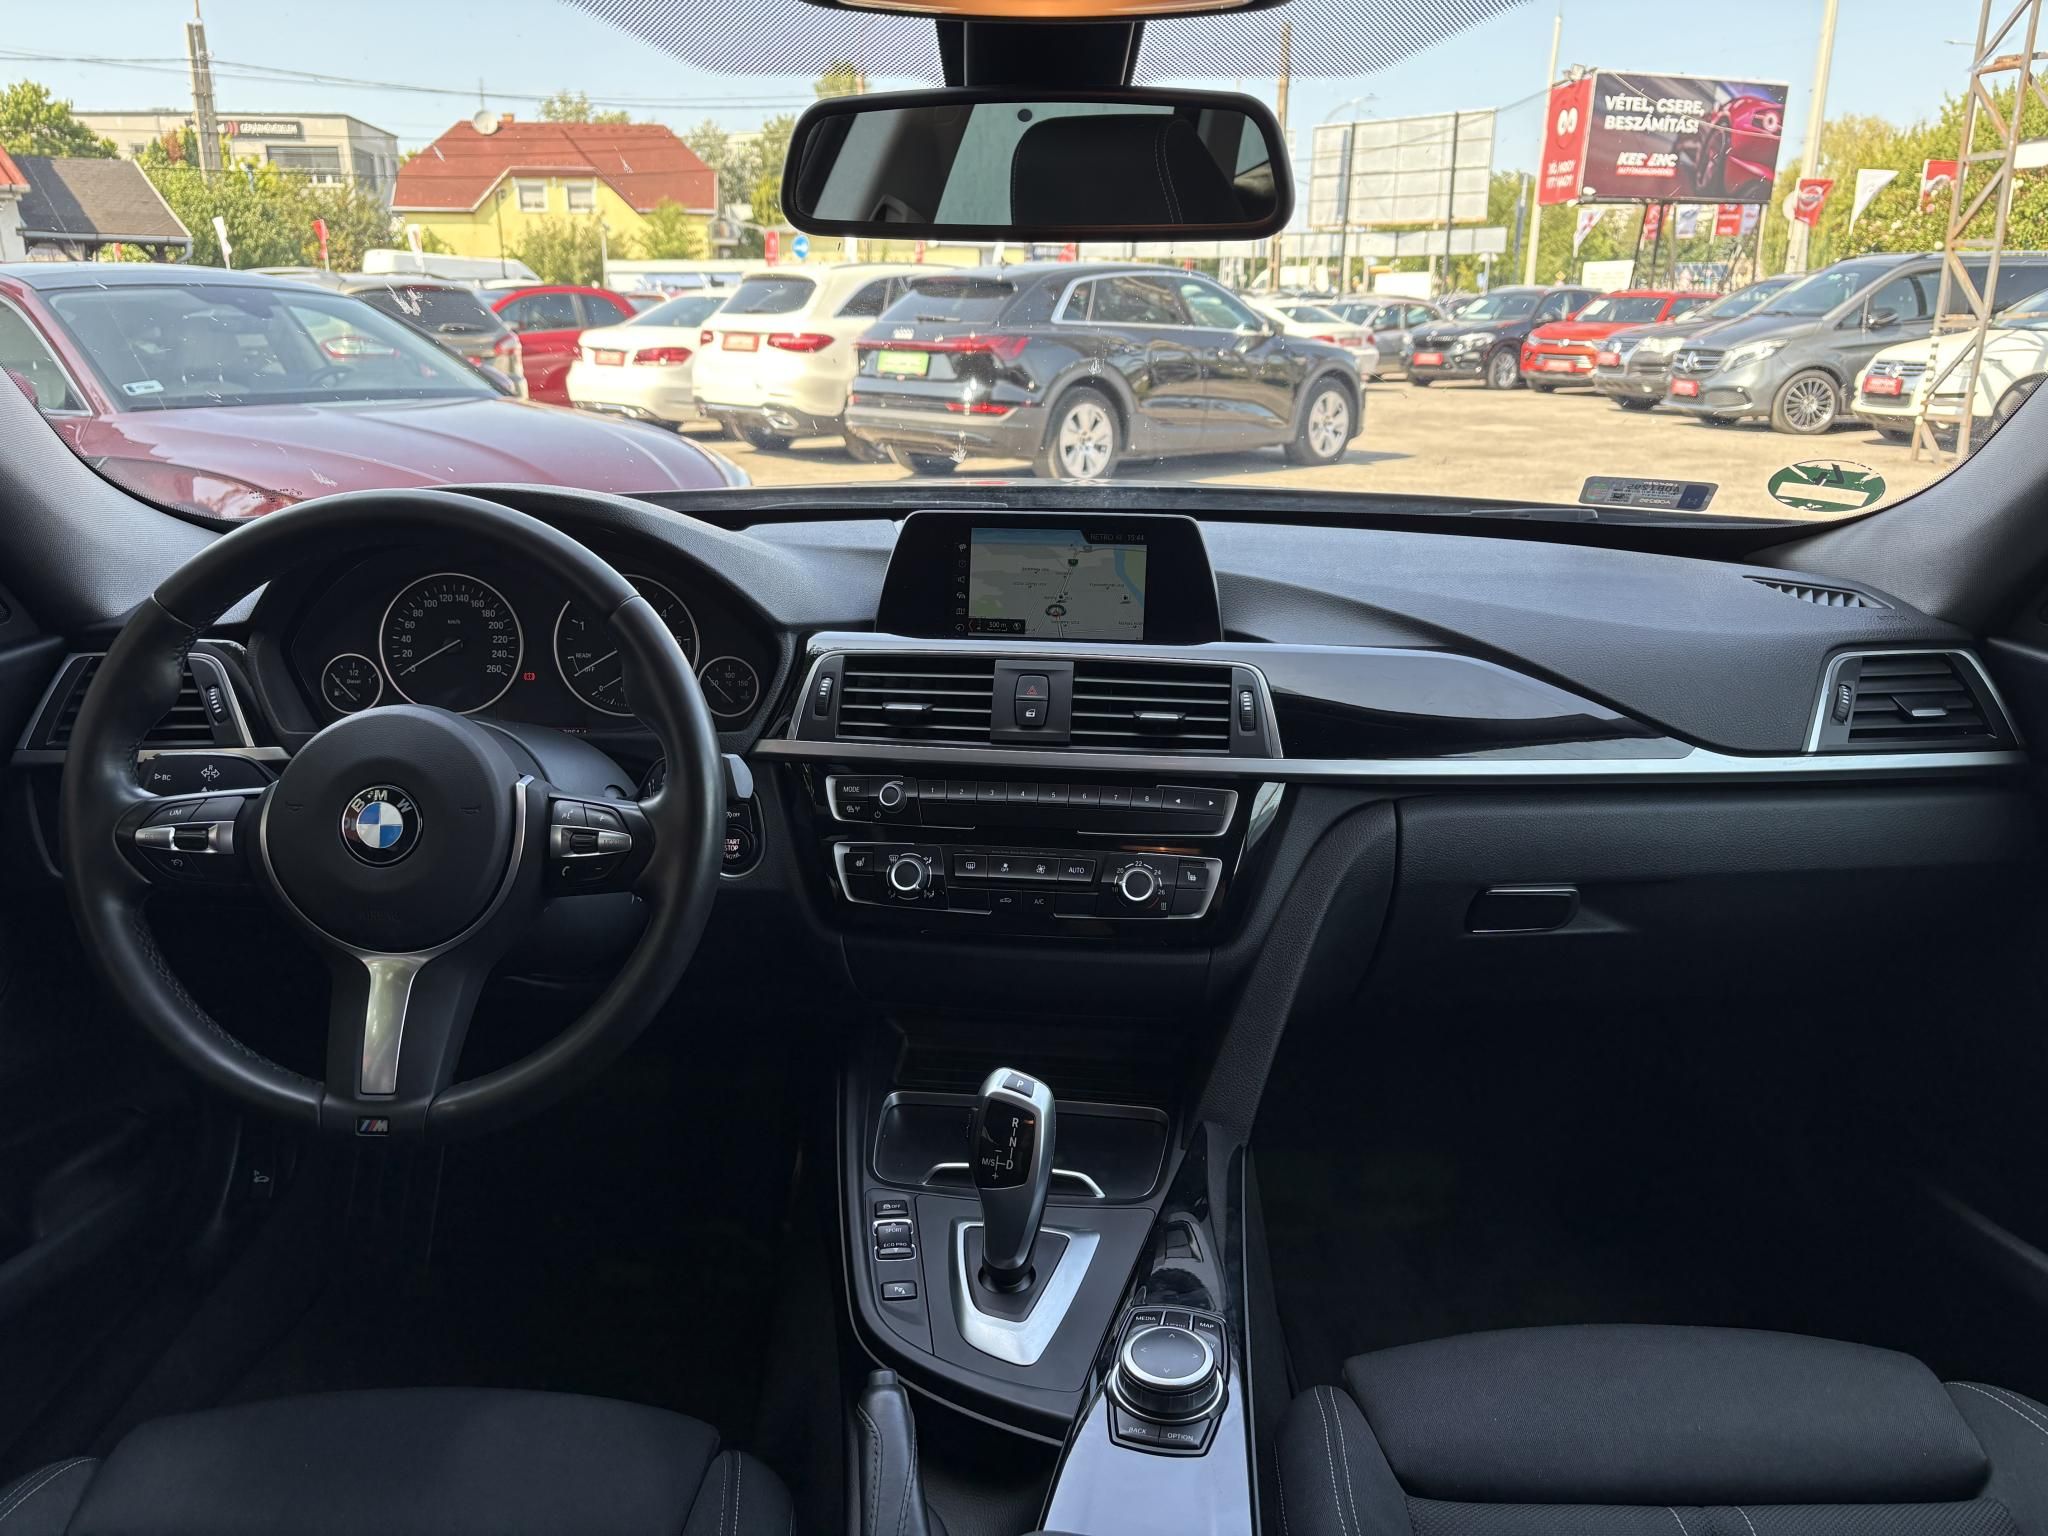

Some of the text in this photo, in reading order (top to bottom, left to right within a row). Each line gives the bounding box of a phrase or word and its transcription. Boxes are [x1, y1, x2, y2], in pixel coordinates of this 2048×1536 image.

[1604, 93, 1705, 116] VÉTEL, CSERE,
[439, 594, 453, 602] 120
[455, 594, 469, 602] 140
[471, 600, 485, 608] 160
[481, 610, 496, 618] 180
[661, 609, 667, 618] 4
[404, 621, 415, 629] 60
[488, 621, 504, 629] 200
[579, 621, 585, 631] 1
[401, 635, 412, 643] 40
[492, 635, 508, 644] 220
[402, 650, 413, 658] 20
[491, 650, 507, 658] 240
[349, 669, 359, 677] 1/2
[486, 665, 502, 673] 260
[350, 789, 413, 813] BMW
[1068, 866, 1085, 874] AUTO
[1016, 1080, 1024, 1088] P
[1011, 1117, 1019, 1128] R
[1009, 1136, 1017, 1148] N
[981, 1157, 995, 1167] M/S
[1005, 1160, 1014, 1170] D
[1128, 1427, 1147, 1435] BACK
[1167, 1432, 1194, 1441] OPTION
